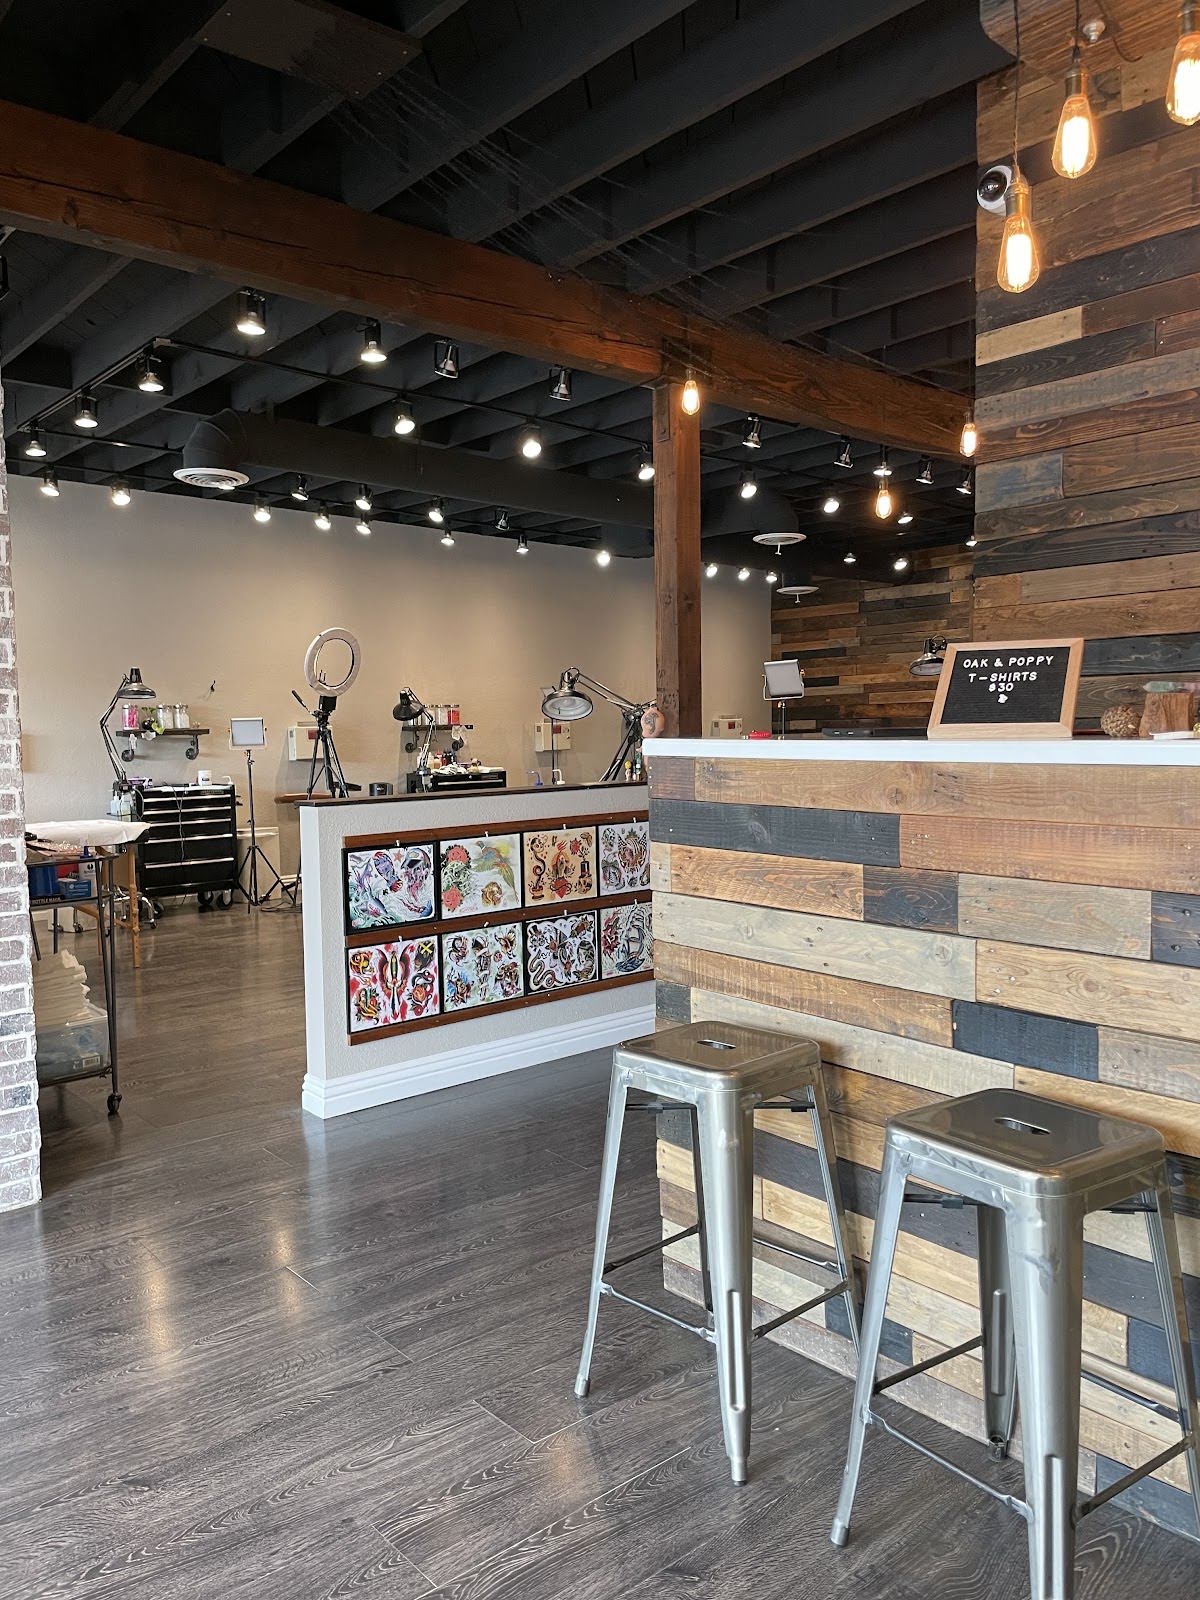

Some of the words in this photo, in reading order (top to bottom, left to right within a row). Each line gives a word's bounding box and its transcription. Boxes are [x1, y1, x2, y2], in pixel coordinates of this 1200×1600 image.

[963, 659, 988, 668] OAK
[994, 657, 1003, 667] &
[1008, 655, 1054, 667] POPPY
[968, 671, 1038, 682] T-SHIRTS
[988, 682, 1014, 692] $30
